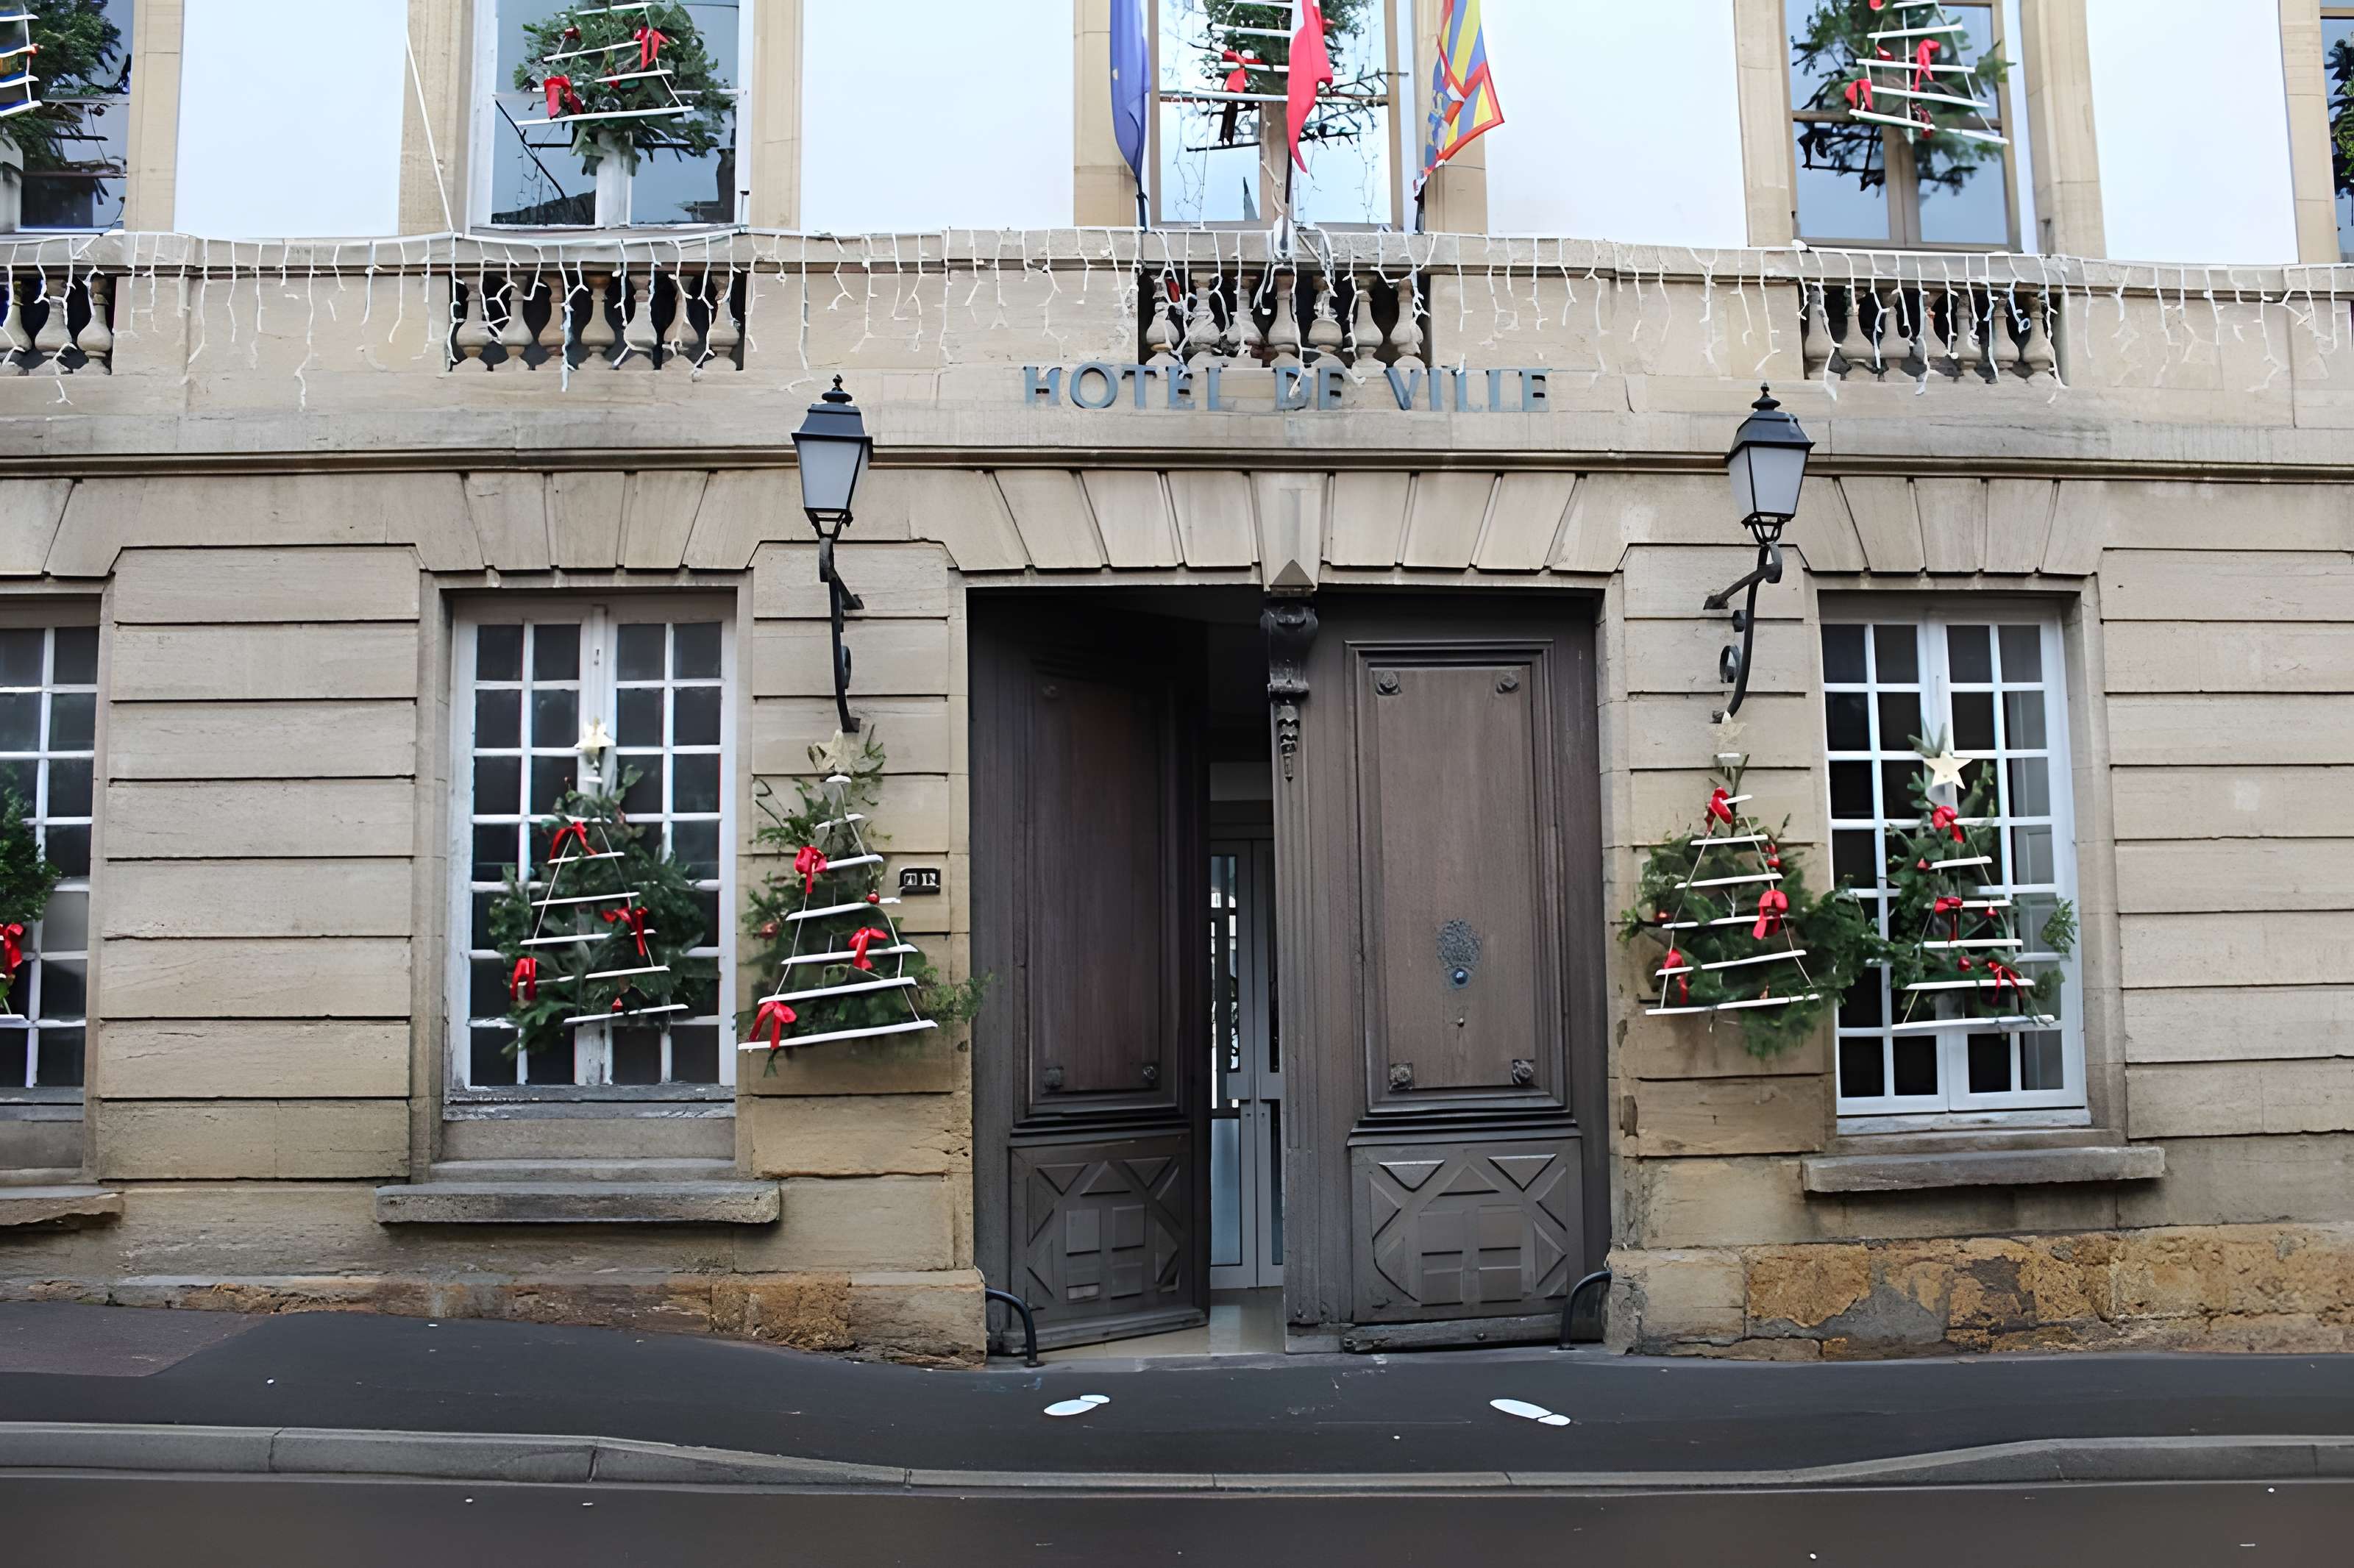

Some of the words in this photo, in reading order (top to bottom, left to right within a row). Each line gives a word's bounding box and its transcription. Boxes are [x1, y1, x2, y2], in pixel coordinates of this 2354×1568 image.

[1023, 361, 1234, 410] HOTEL
[1276, 367, 1345, 411] DE
[1384, 367, 1550, 413] VILLE
